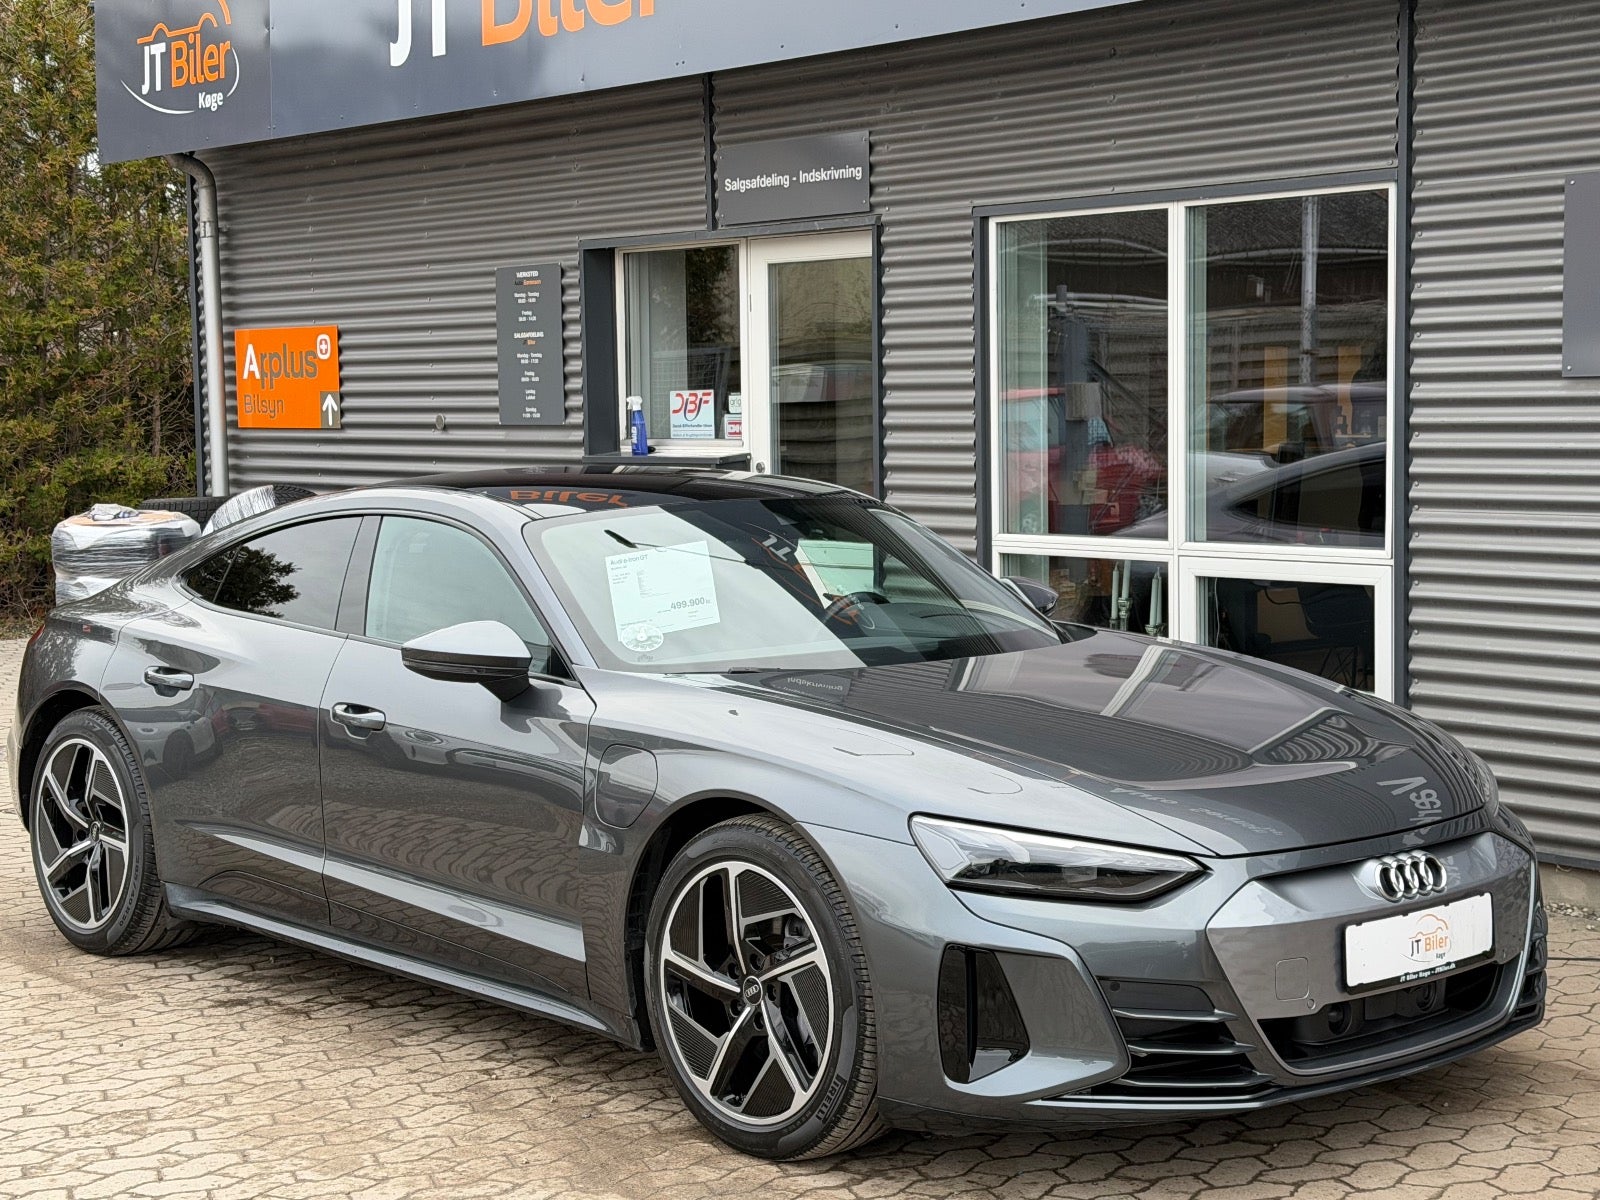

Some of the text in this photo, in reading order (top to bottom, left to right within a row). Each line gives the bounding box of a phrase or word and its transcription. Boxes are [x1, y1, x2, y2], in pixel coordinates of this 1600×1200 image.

[141, 32, 231, 95] JT Biler
[198, 91, 224, 112] Køge
[724, 173, 790, 193] Salgsafdeling
[799, 165, 863, 184] Indskrivning
[244, 393, 285, 419] Bilsyn
[670, 597, 705, 610] 499.900
[1411, 934, 1449, 957] JT Biler
[814, 1073, 848, 1125] PIRELLI
